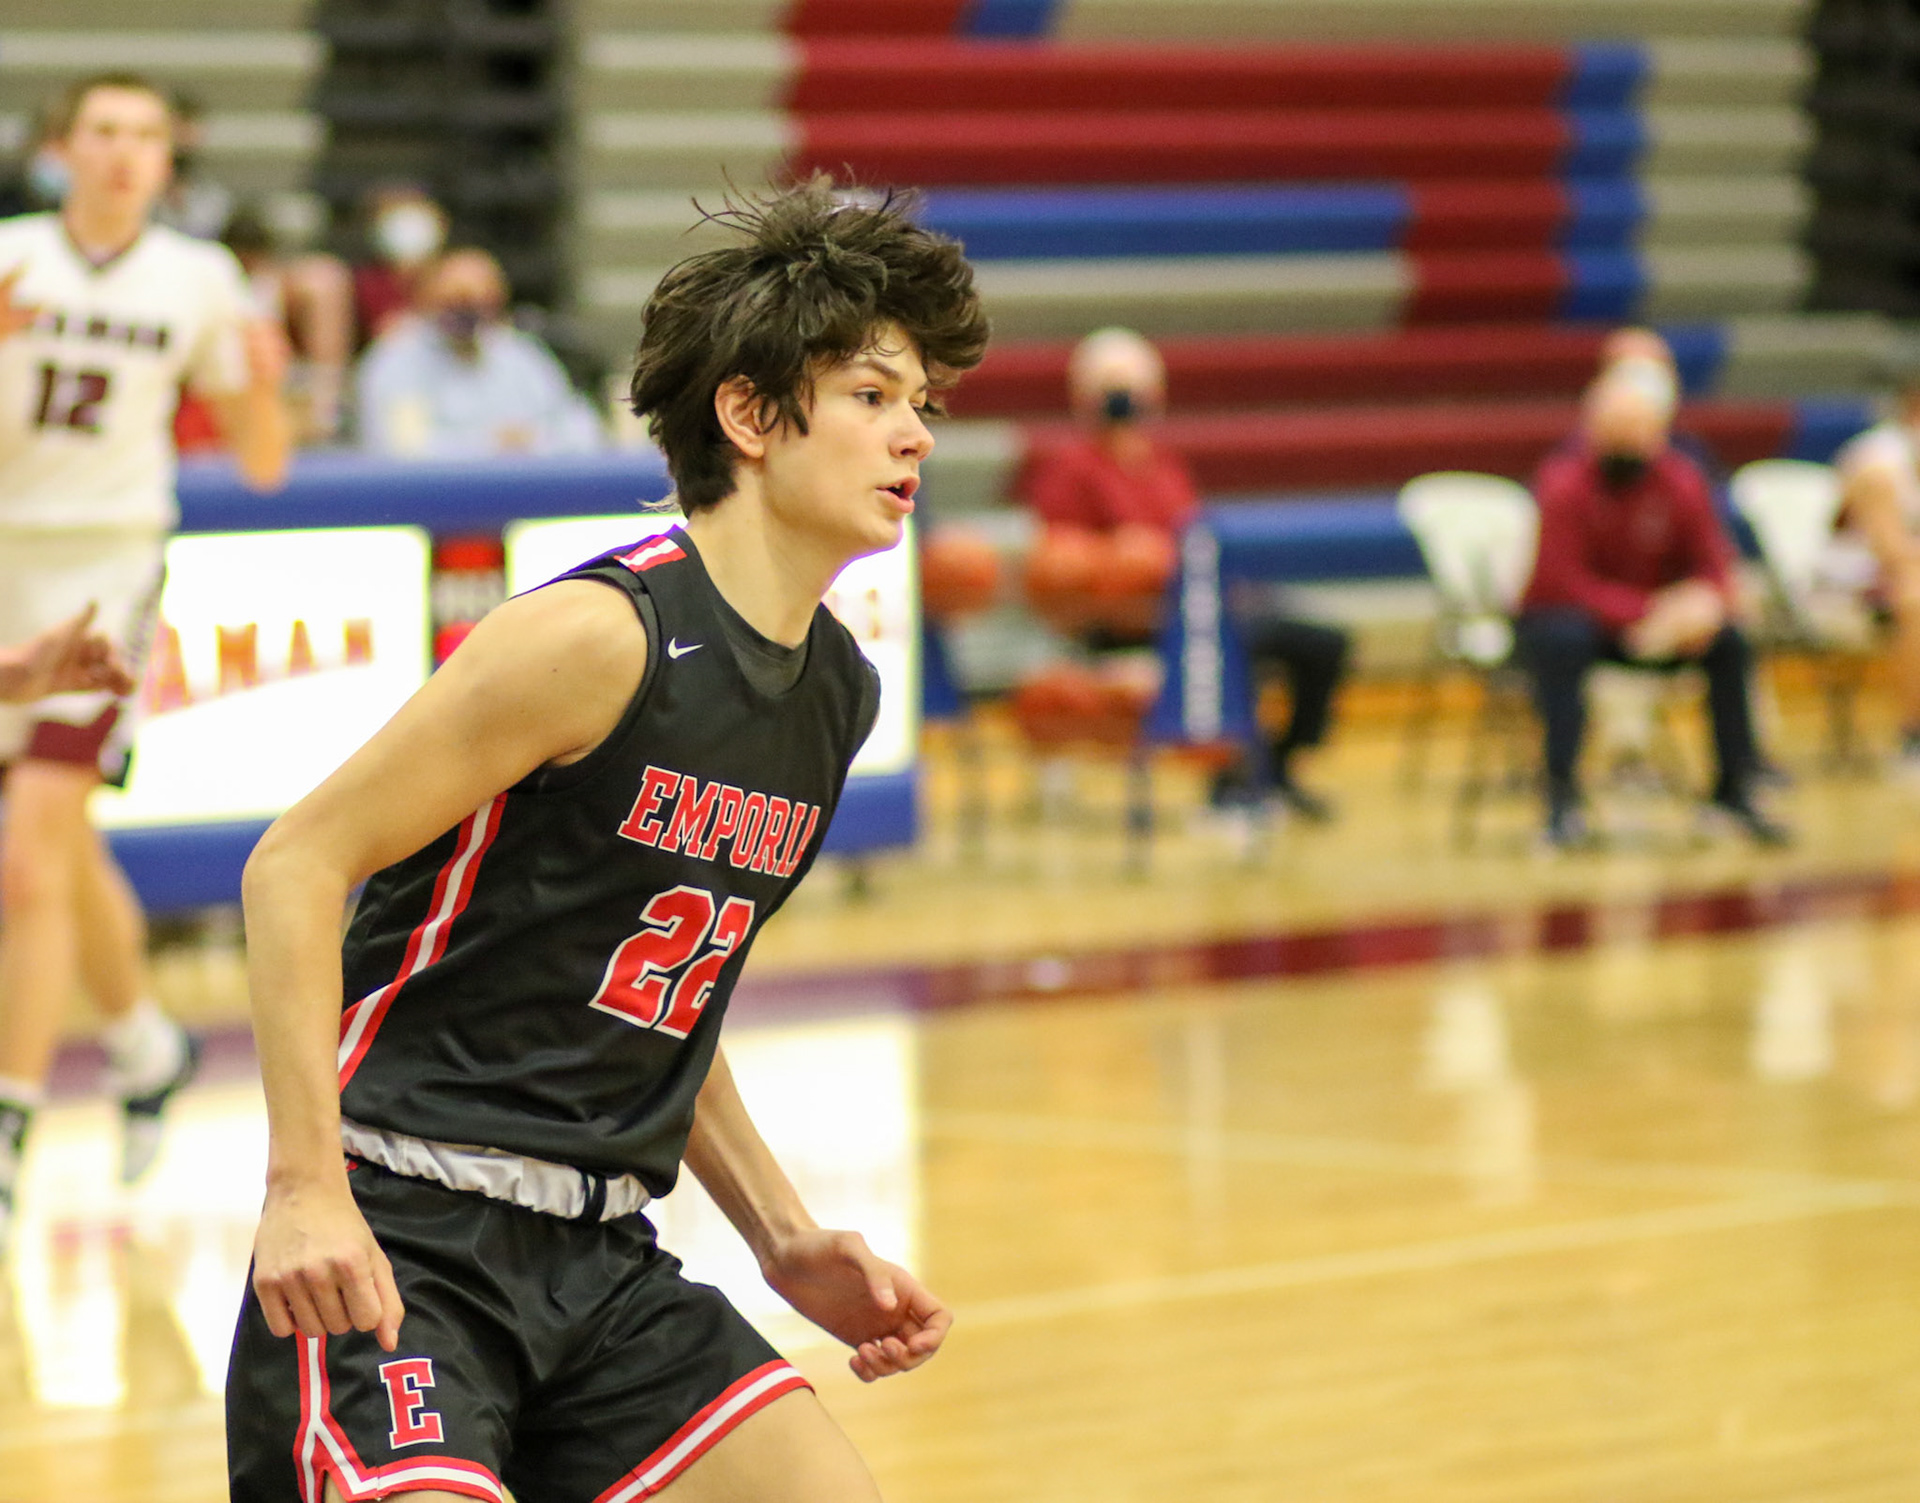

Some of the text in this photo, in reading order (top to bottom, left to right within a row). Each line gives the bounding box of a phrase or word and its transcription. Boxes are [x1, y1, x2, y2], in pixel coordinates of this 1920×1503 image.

[36, 360, 109, 432] 12
[588, 884, 756, 1041] 22
[379, 1358, 445, 1450] E
